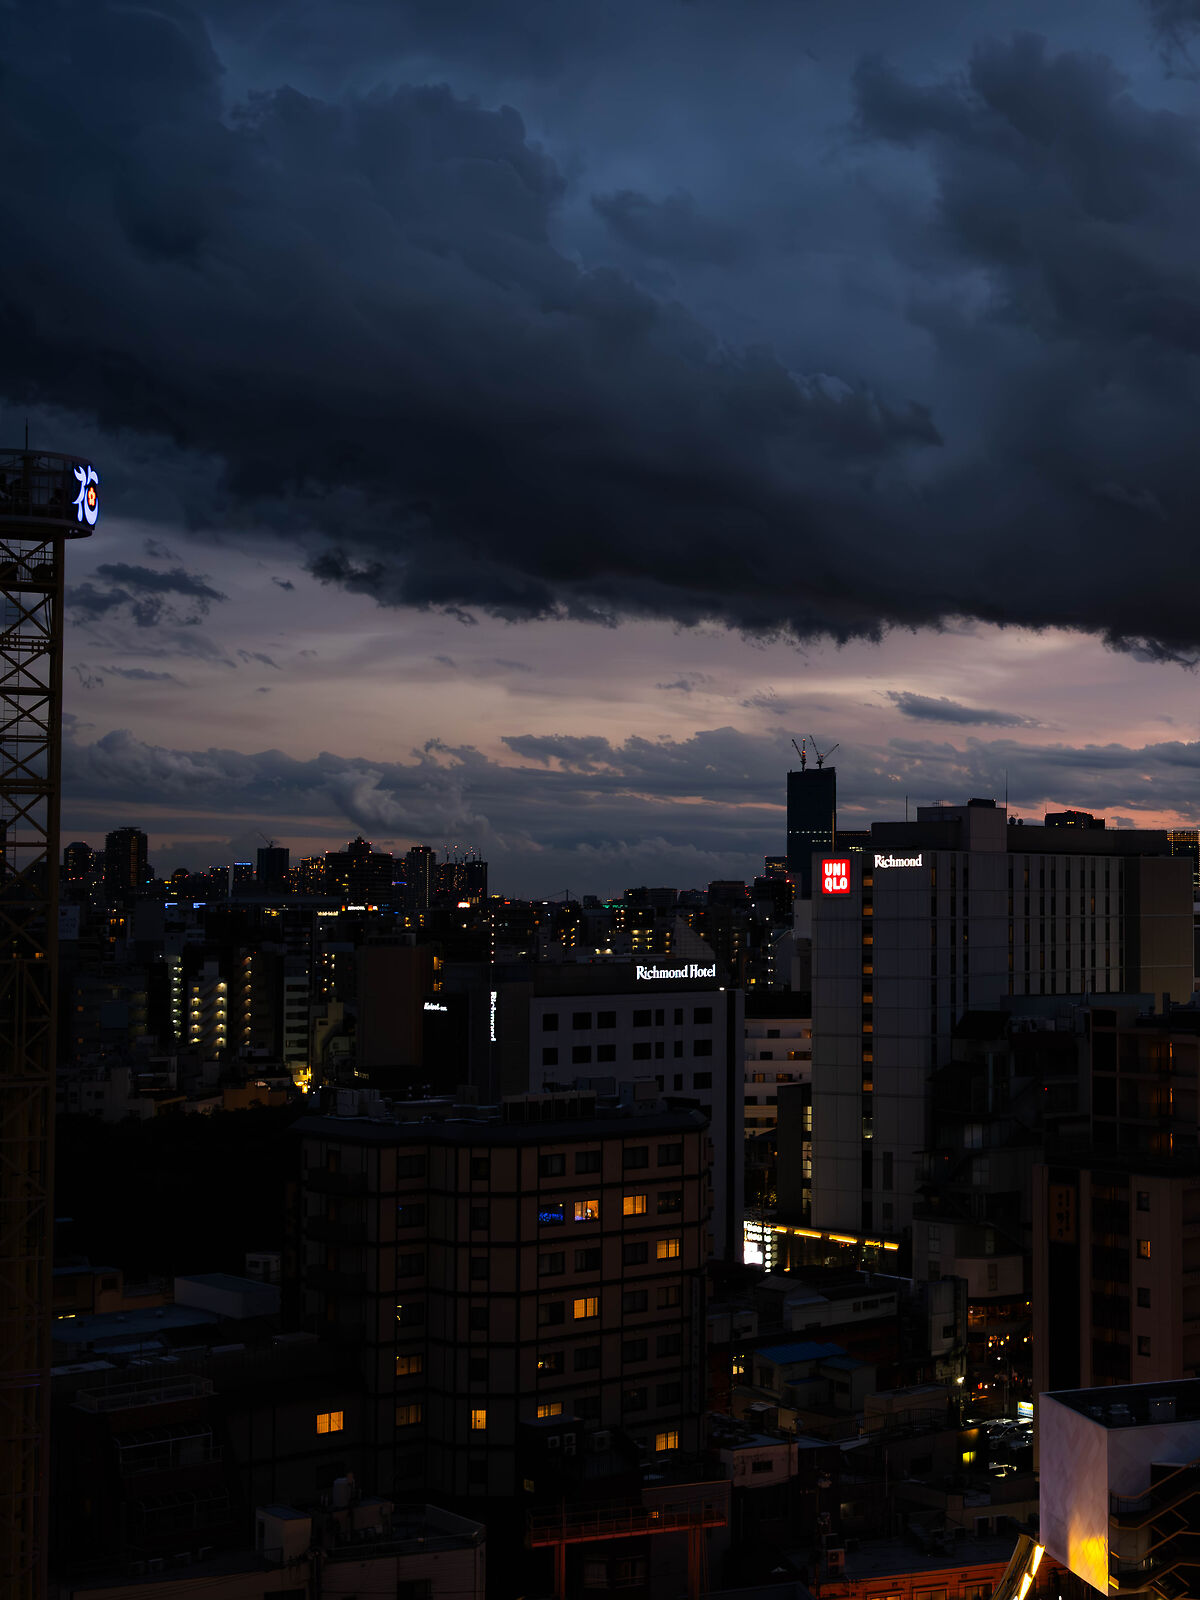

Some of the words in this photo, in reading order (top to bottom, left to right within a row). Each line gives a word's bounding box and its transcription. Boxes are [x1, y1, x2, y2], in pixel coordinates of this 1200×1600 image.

[874, 854, 922, 868] Richmond
[824, 863, 846, 876] UNI
[824, 877, 848, 892] QLO
[636, 965, 688, 980] Richmond
[689, 963, 716, 979] Hotel
